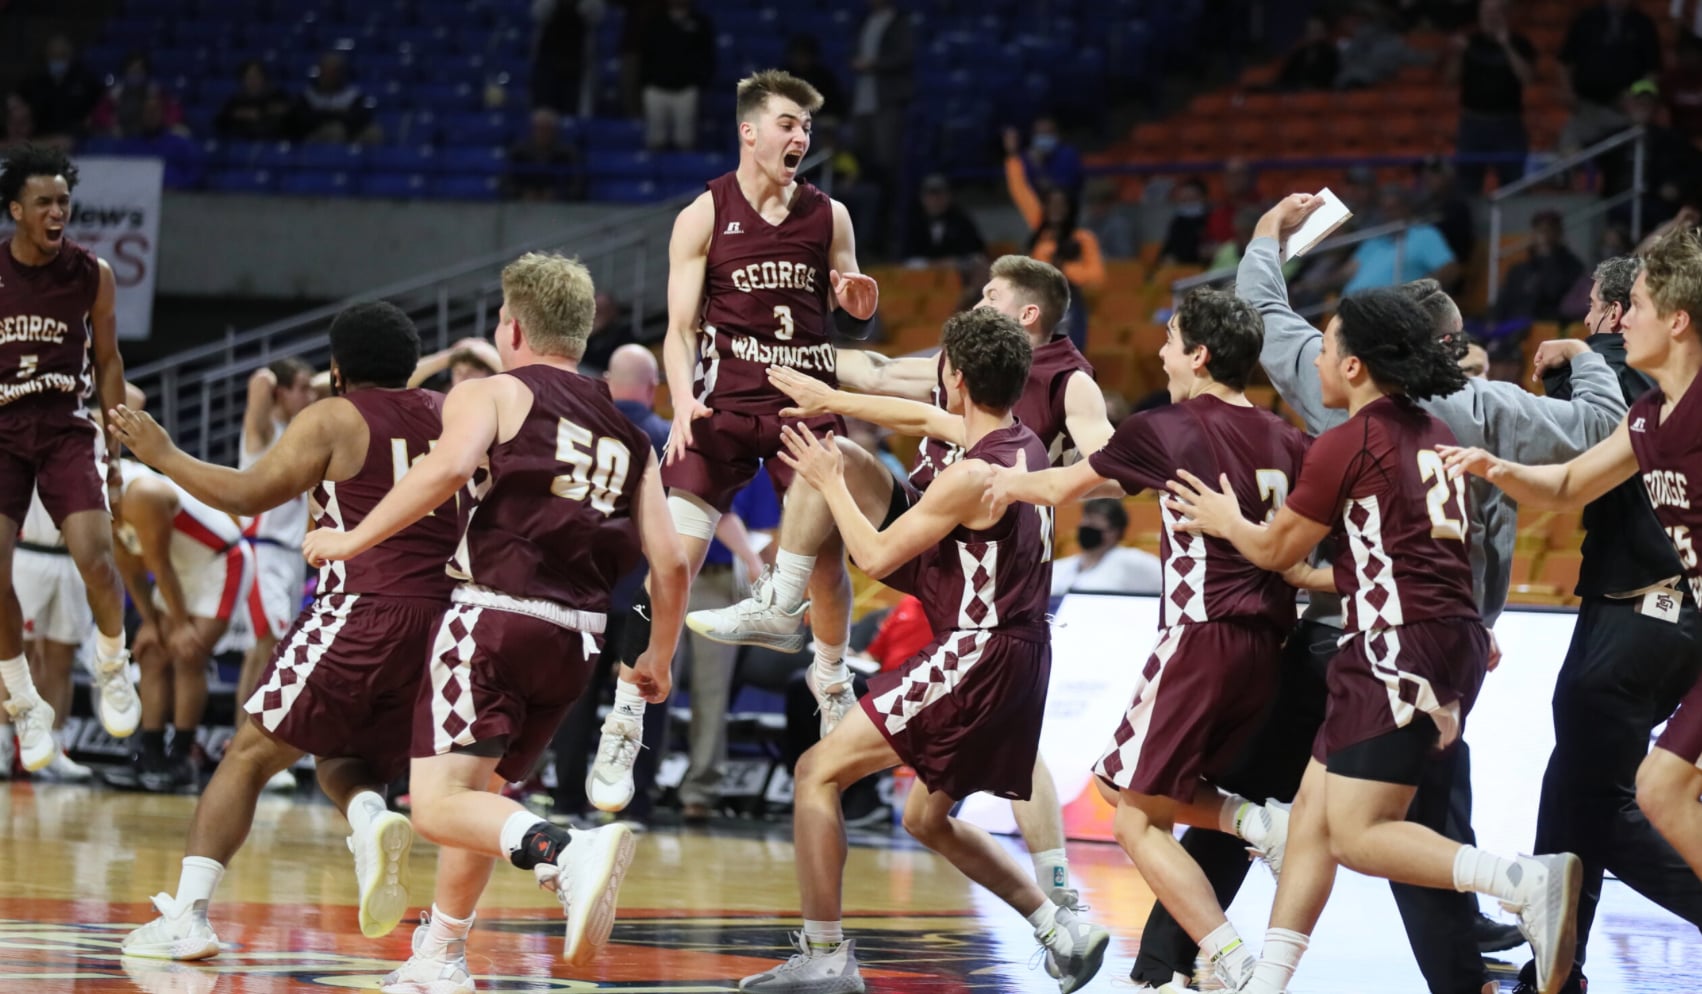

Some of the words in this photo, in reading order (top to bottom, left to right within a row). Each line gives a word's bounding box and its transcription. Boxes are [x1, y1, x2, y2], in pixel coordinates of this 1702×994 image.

[731, 260, 817, 293] GEORGE
[773, 305, 794, 341] 3
[16, 354, 39, 378] 5
[550, 416, 631, 518] 50
